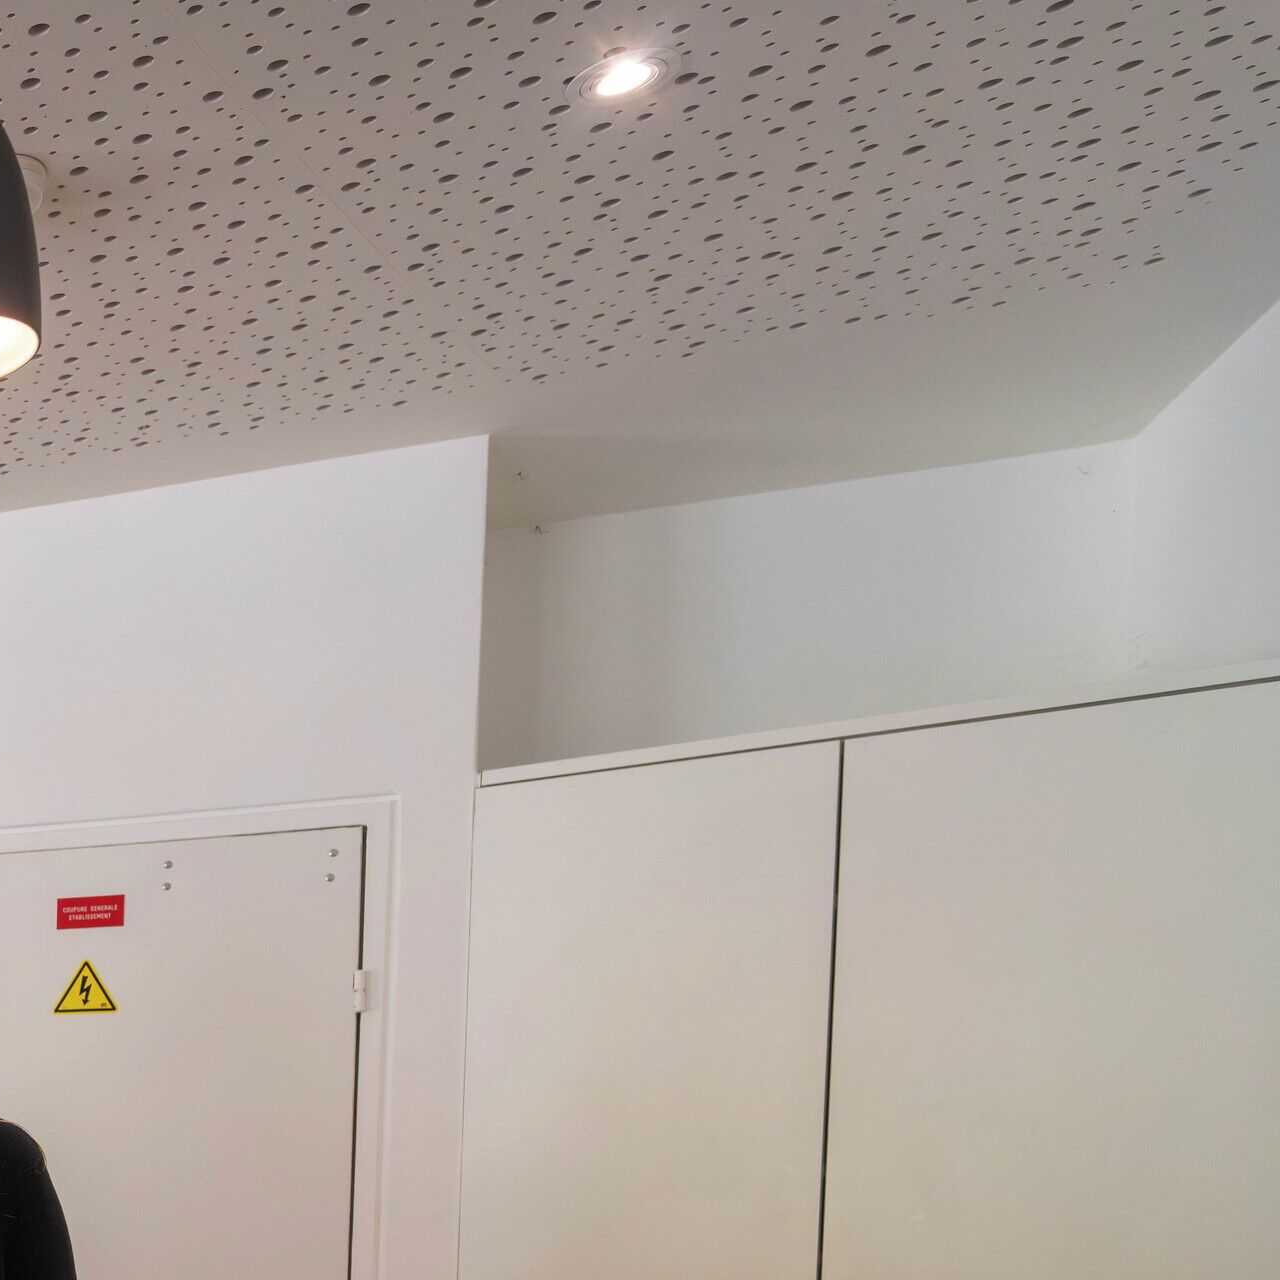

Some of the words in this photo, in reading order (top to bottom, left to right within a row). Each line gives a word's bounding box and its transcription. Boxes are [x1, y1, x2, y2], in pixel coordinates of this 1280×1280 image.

[62, 905, 88, 913] COUPURE
[90, 903, 118, 912] GENERALE
[68, 912, 111, 921] ETABLISSEMENT
